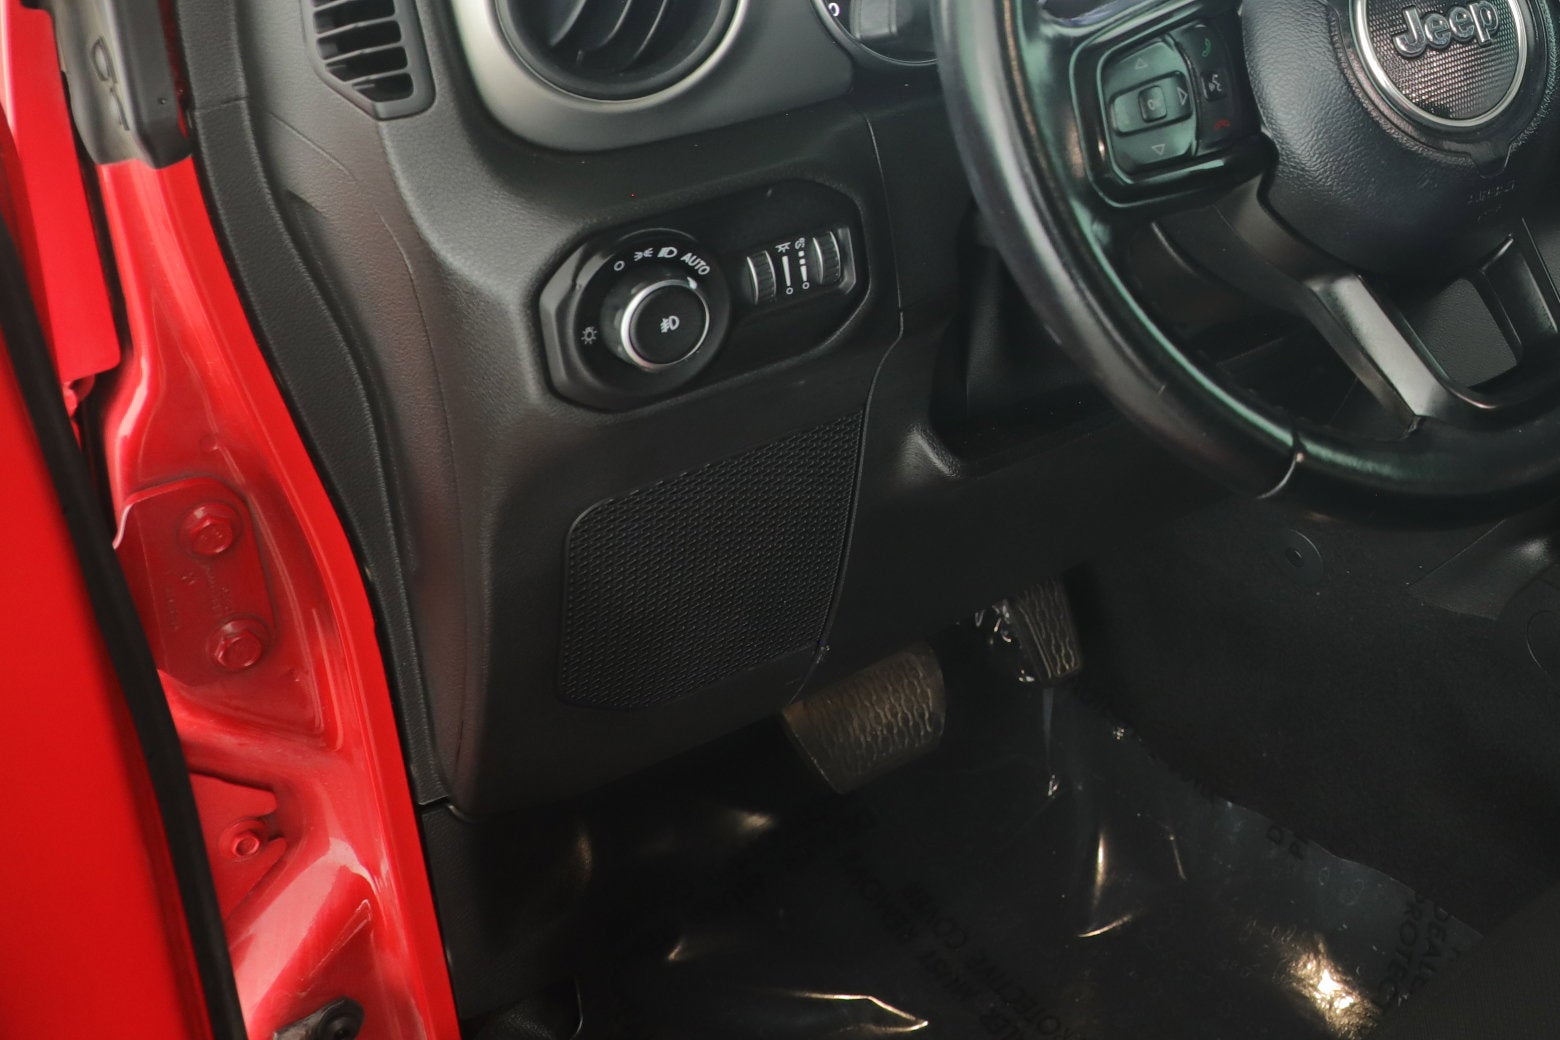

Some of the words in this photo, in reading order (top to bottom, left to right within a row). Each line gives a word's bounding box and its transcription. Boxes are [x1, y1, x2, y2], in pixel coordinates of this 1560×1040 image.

[828, 2, 840, 18] 0
[1392, 0, 1499, 59] Jeep
[680, 252, 711, 276] AUTO
